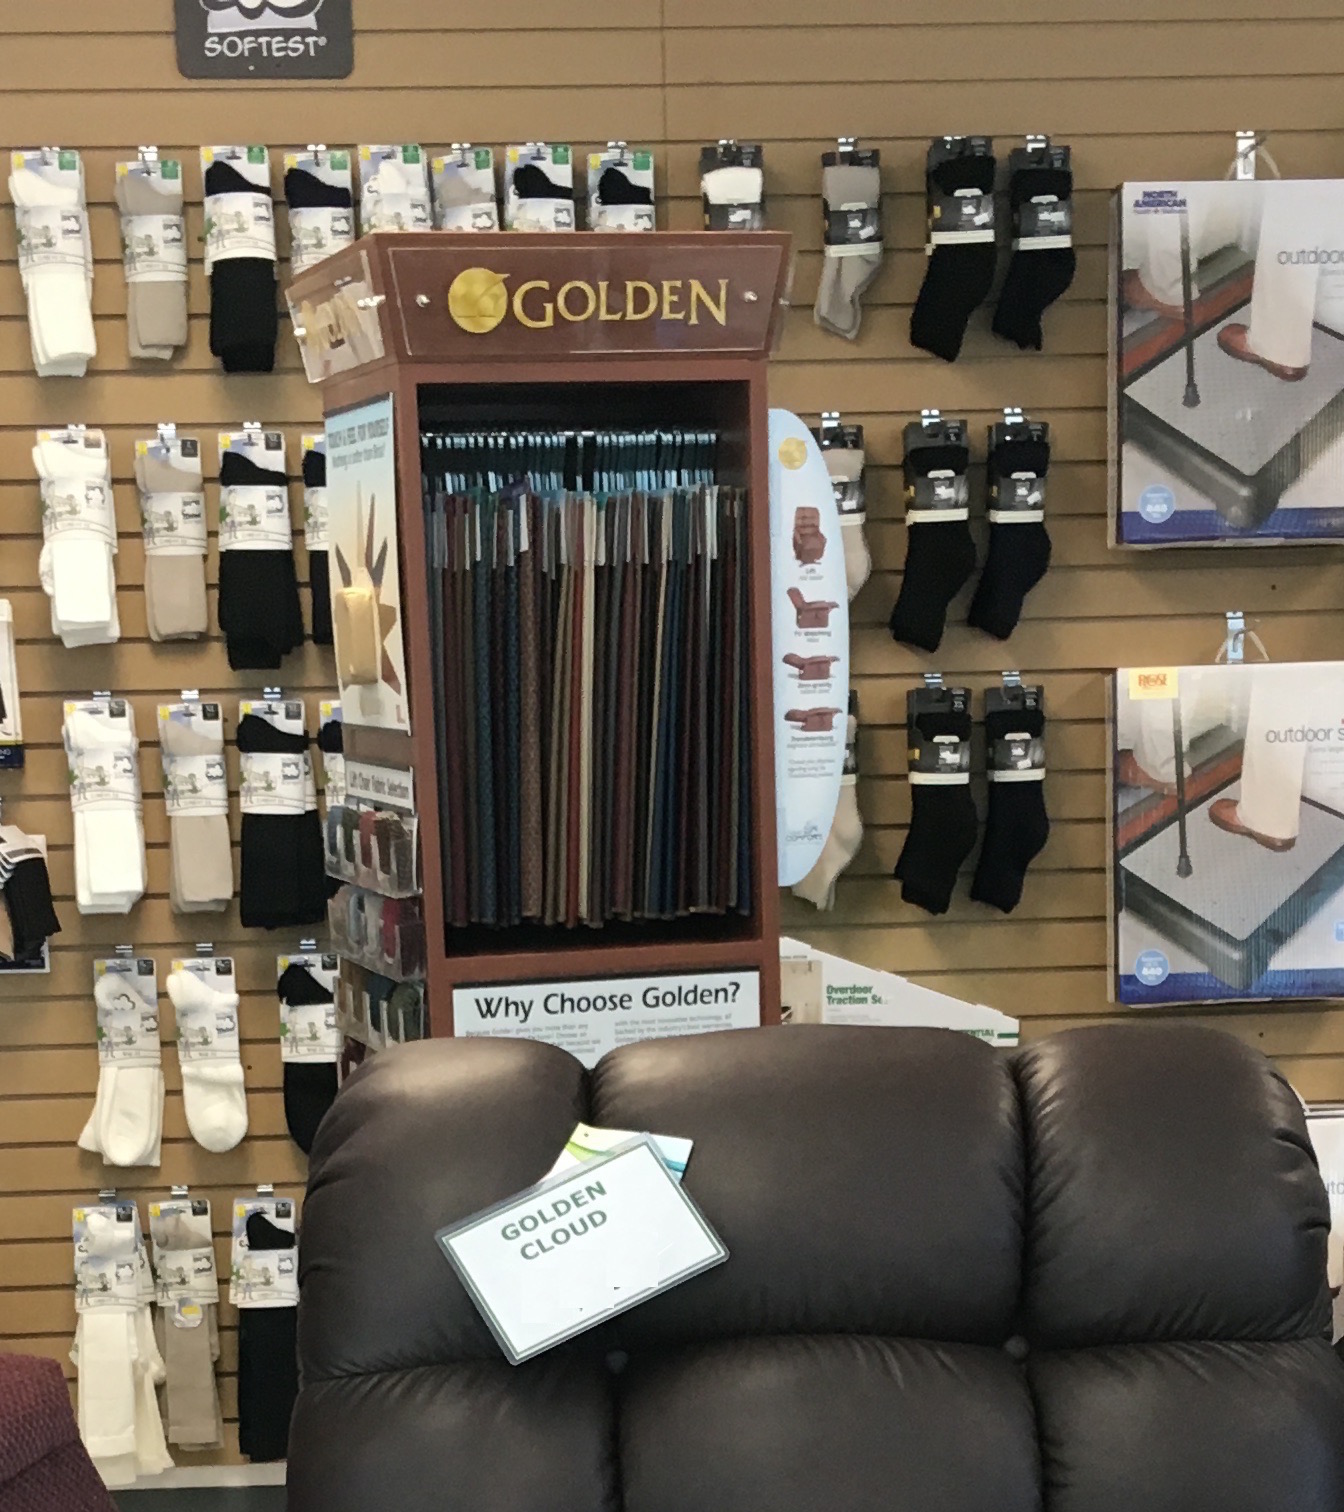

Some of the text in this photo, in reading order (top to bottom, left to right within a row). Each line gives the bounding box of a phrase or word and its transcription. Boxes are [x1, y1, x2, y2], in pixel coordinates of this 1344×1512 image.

[513, 279, 729, 328] GOLDEN
[1265, 724, 1333, 744] outdoor
[475, 981, 741, 1024] Why Choose Golden?
[826, 984, 873, 995] Overdoor
[826, 995, 868, 1006] Traction
[501, 1180, 607, 1241] GOLDEN
[520, 1210, 607, 1260] CLOUD
